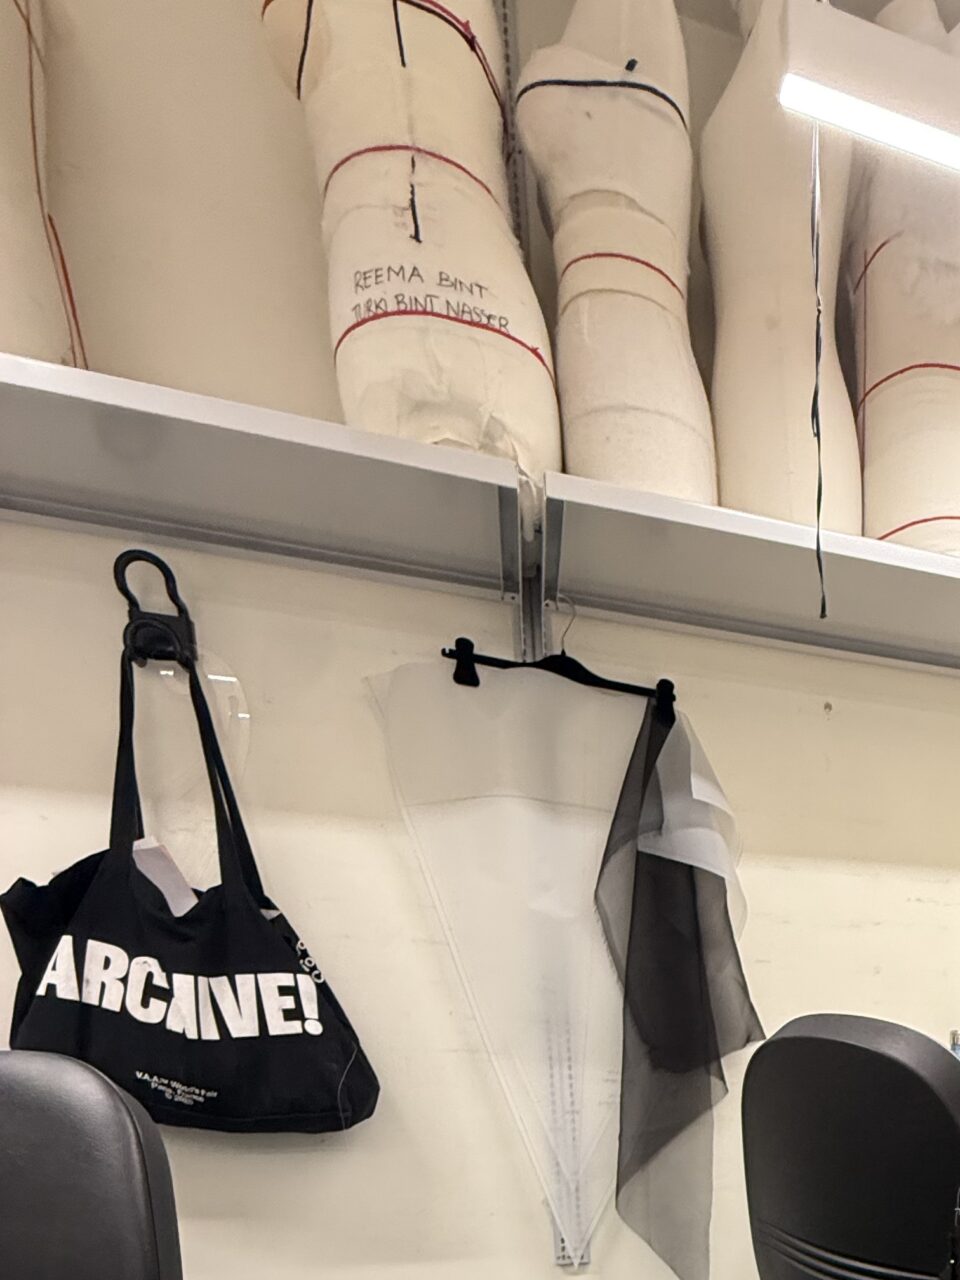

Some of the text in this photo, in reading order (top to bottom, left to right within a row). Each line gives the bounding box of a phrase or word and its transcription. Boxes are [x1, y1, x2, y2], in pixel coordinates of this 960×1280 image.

[353, 265, 489, 299] REEMA BINT
[394, 293, 440, 313] BINT
[445, 300, 510, 333] NASSER
